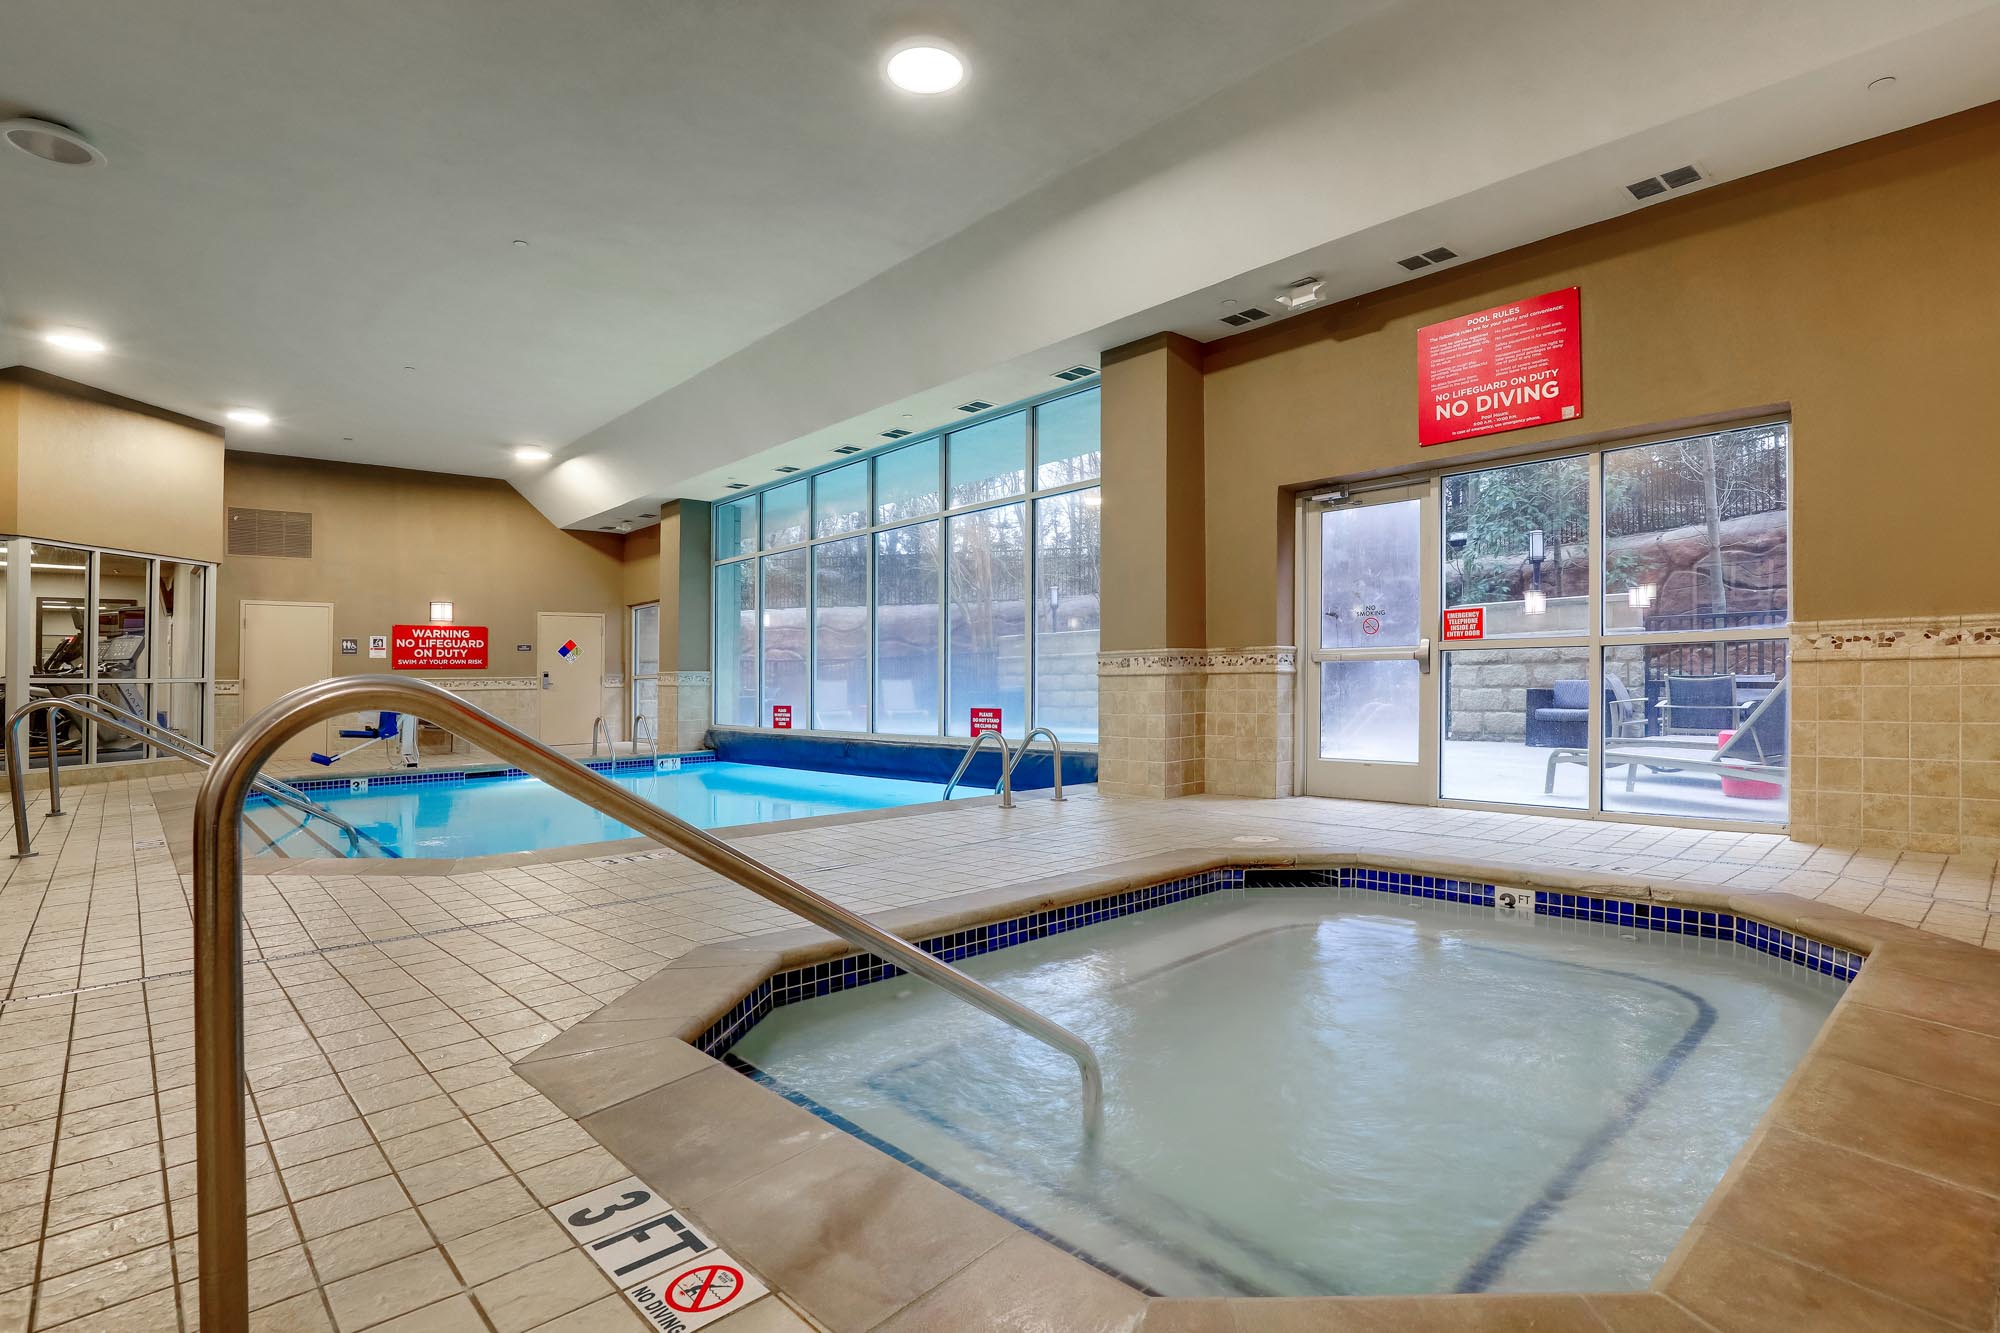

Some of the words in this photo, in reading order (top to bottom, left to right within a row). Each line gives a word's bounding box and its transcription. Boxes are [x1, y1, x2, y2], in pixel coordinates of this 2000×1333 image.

[1467, 315, 1490, 326] POOL
[1492, 307, 1520, 319] RULES
[1530, 304, 1564, 317] convenience:
[1436, 393, 1450, 402] NO
[1453, 380, 1507, 398] LIFEGUARD
[1510, 376, 1526, 385] ON
[1530, 369, 1559, 382] DUTY
[1436, 400, 1468, 421] NO
[1477, 381, 1559, 412] DIVING
[396, 639, 415, 648] NO
[419, 639, 484, 648] LIFEGUARD
[412, 629, 470, 638] WARNING
[414, 649, 432, 658] ON
[436, 649, 468, 658] DUTY
[125, 688, 145, 716] MATR
[1518, 895, 1531, 905] FT
[568, 1190, 651, 1227] 3
[592, 1214, 708, 1277] FT
[631, 1286, 656, 1302] NO
[644, 1300, 686, 1333] DIVING
